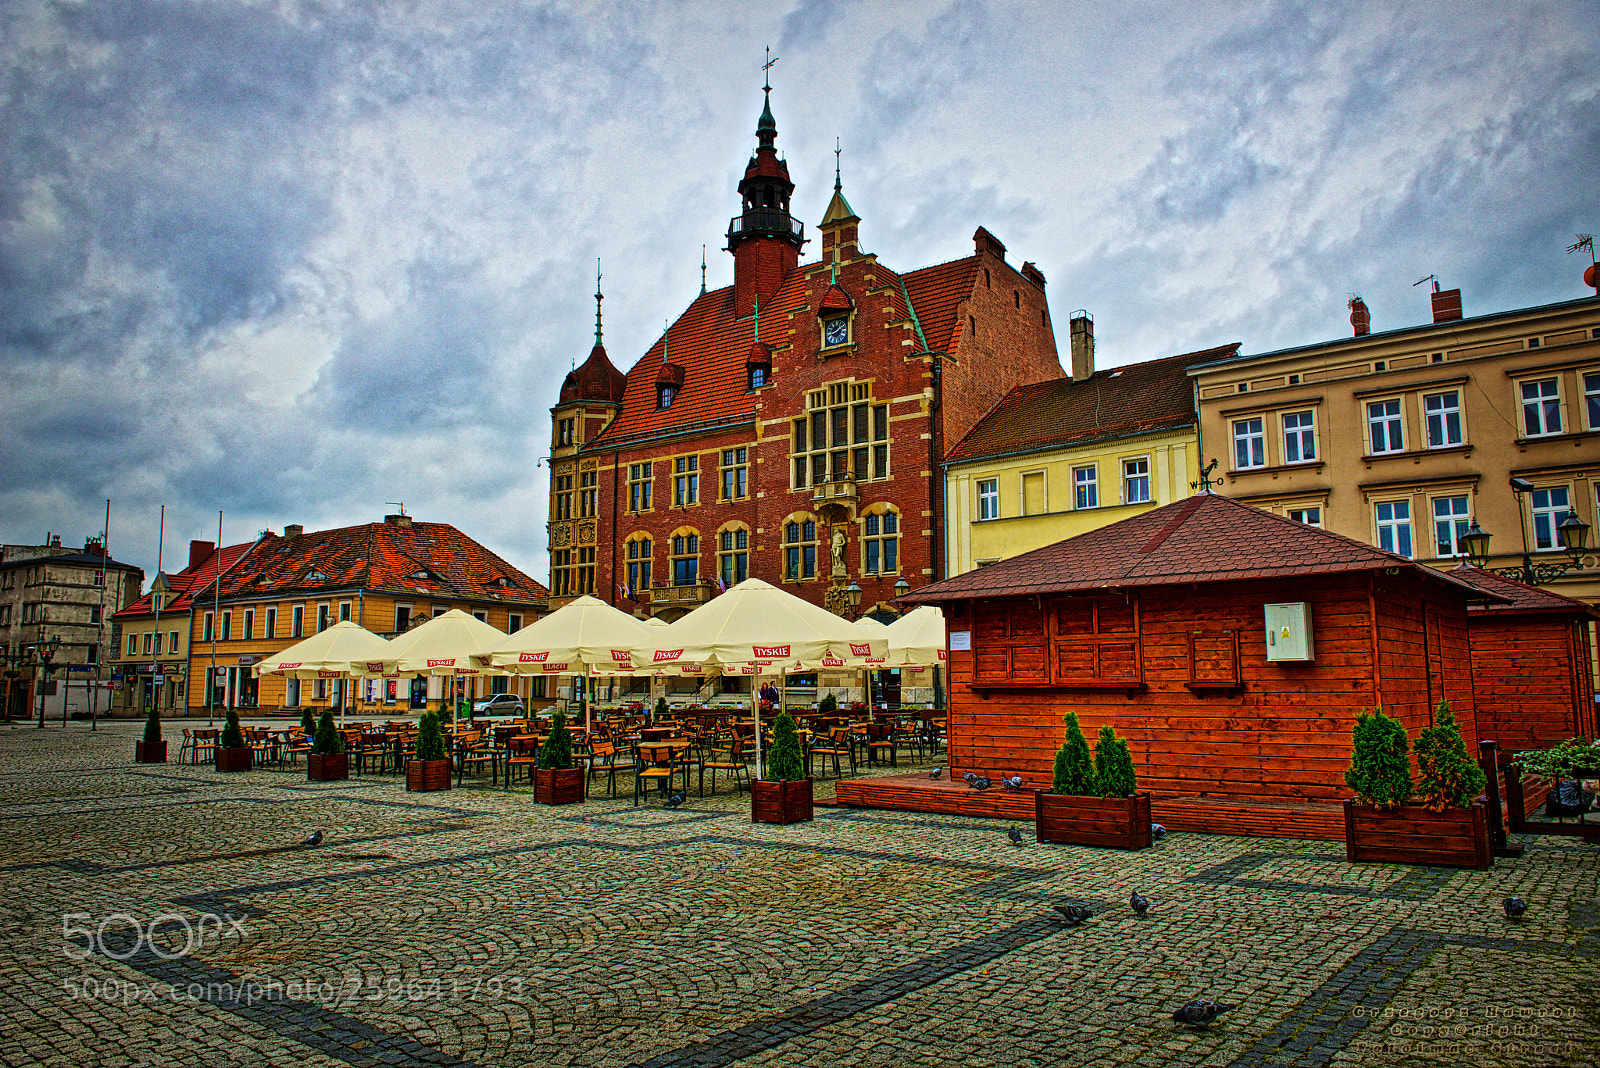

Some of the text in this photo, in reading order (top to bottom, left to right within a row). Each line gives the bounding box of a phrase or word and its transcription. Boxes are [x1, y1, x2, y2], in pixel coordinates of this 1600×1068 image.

[655, 650, 681, 660] TYSKIE
[755, 646, 789, 656] TYSKIE
[851, 645, 870, 655] TYSKIE
[521, 652, 547, 661] TYSKIE
[428, 659, 454, 667] TYSKIE
